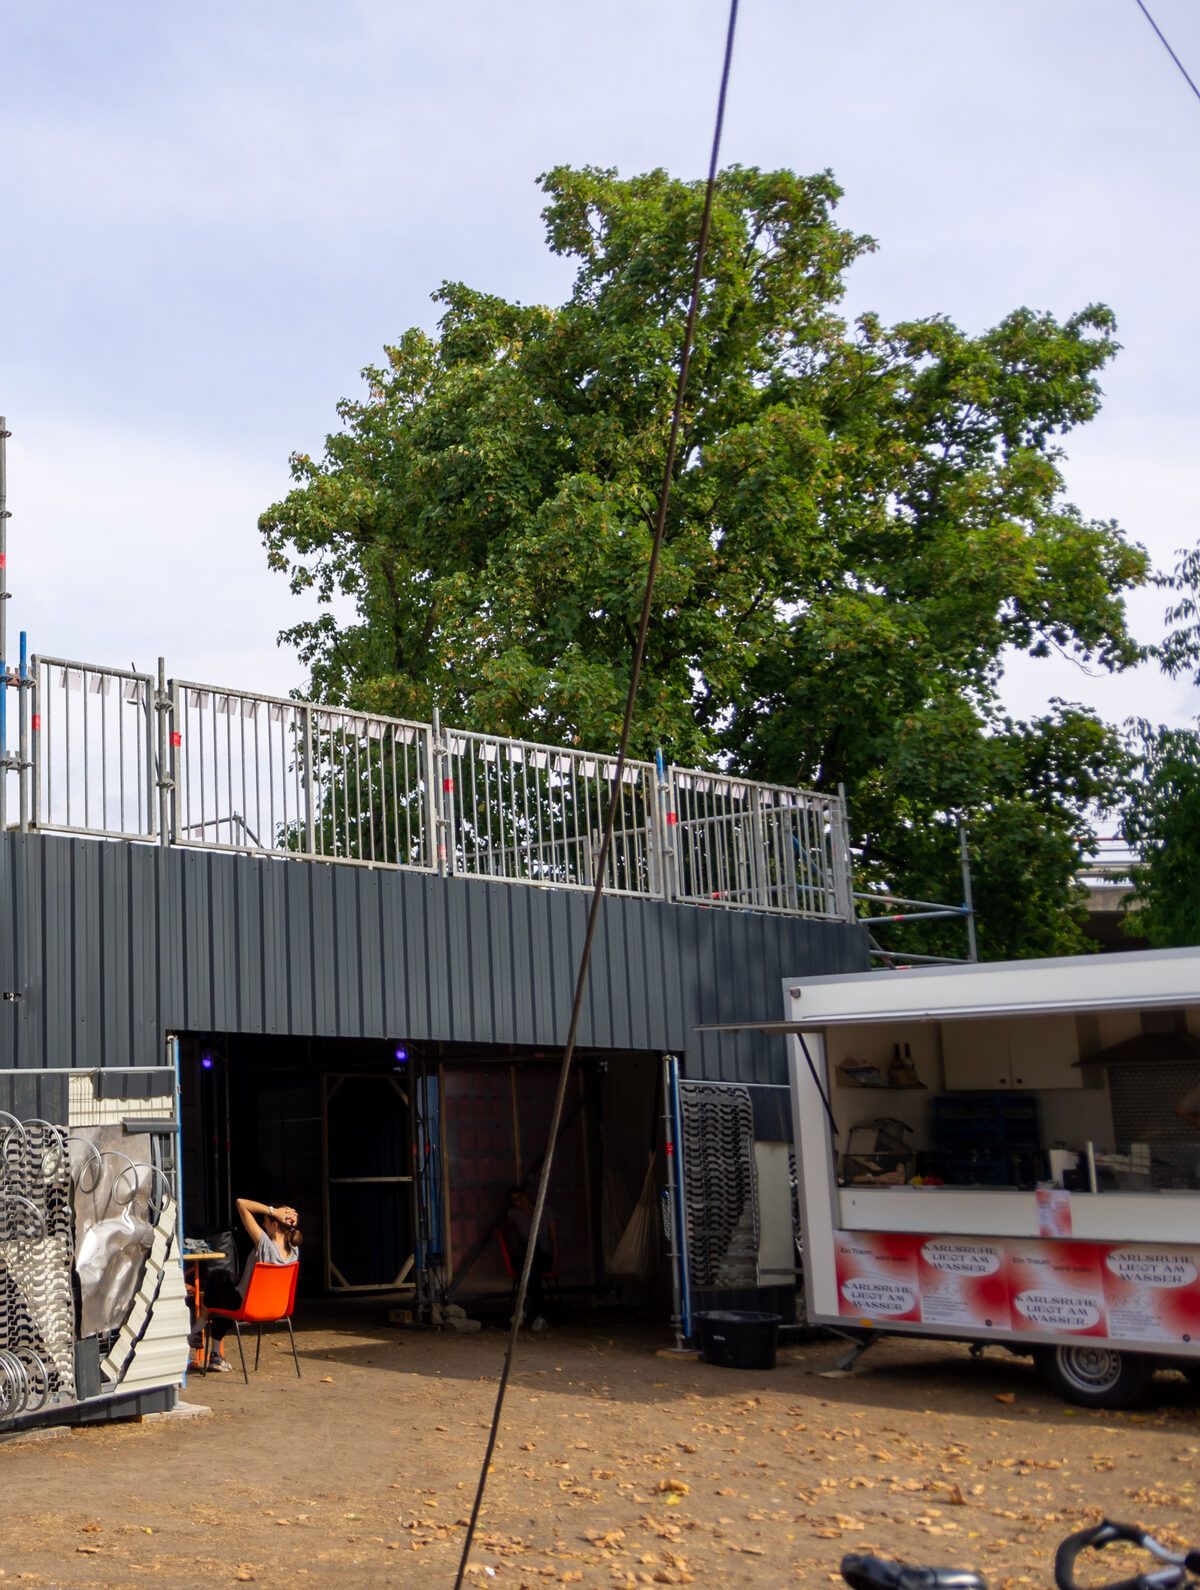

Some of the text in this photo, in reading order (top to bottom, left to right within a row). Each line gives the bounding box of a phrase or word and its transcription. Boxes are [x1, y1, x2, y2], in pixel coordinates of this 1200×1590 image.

[922, 1244, 998, 1255] KARLSRUHE
[1107, 1253, 1195, 1264] KARLSRUHE
[1164, 1265, 1185, 1273] AM
[842, 1282, 913, 1294] KARLSRUHE
[888, 1294, 905, 1302] AM
[1016, 1295, 1097, 1308] KARLSRUHE
[1068, 1307, 1088, 1316] AM
